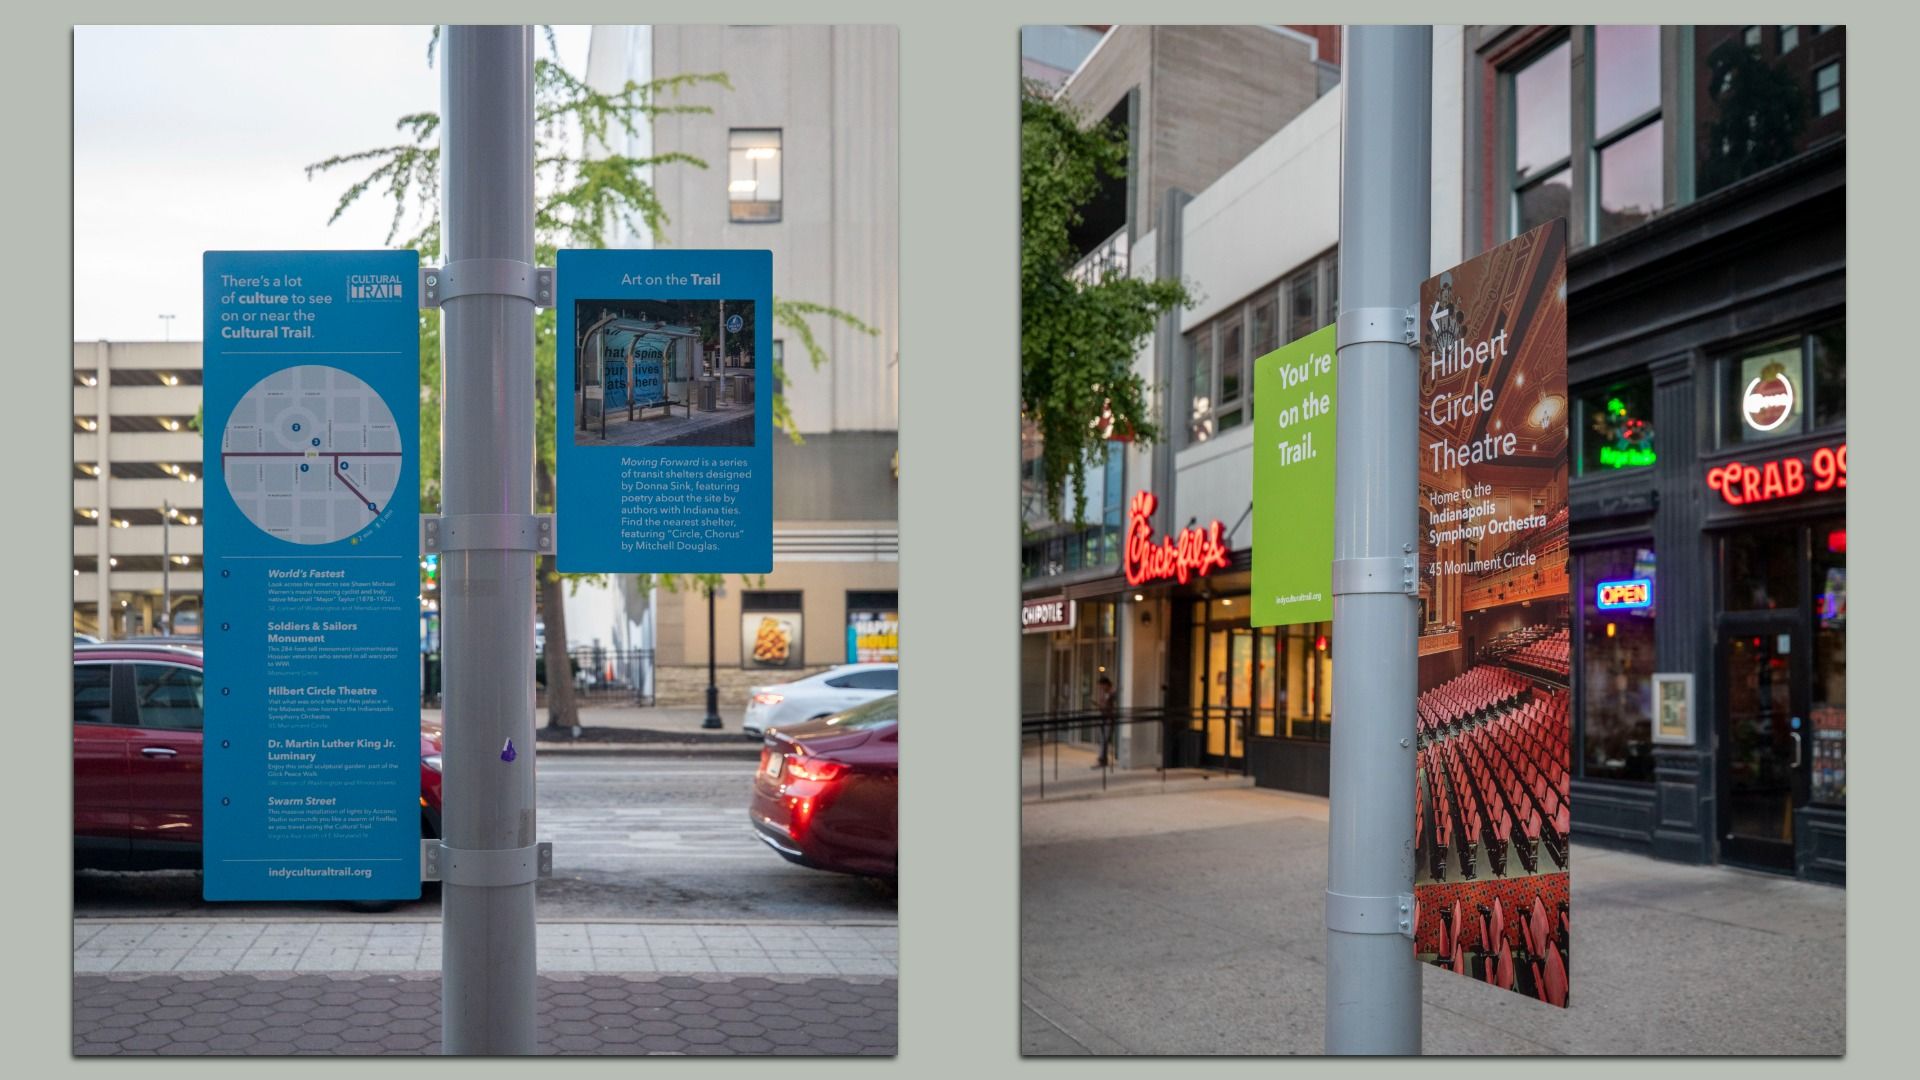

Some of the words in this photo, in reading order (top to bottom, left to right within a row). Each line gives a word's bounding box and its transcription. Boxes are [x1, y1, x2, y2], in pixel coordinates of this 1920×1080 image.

[221, 275, 269, 287] There's
[273, 278, 280, 287] a
[285, 275, 302, 287] lot
[352, 275, 401, 283] CULTURAL
[622, 274, 642, 285] Art
[646, 276, 662, 285] on
[666, 274, 687, 285] the
[691, 274, 720, 285] Trail
[352, 285, 402, 298] TRAIL
[221, 292, 236, 304] of
[239, 292, 288, 304] culture
[292, 294, 305, 304] to
[309, 296, 332, 304] see
[221, 313, 238, 321] on
[243, 313, 256, 321] or
[260, 313, 290, 321] near
[294, 310, 315, 321] the
[221, 327, 277, 338] Cultural
[281, 327, 314, 338] Trail.
[1431, 329, 1508, 380] Hilbert
[635, 363, 660, 375] lives
[1279, 352, 1331, 390] You're
[635, 378, 658, 388] here
[1430, 382, 1494, 426] Circle
[1279, 406, 1299, 429] on
[1302, 392, 1330, 420] the
[1278, 432, 1316, 466] Trail.
[1430, 432, 1517, 472] Theatre
[621, 458, 657, 468] Moving
[660, 458, 699, 466] Forward
[702, 458, 709, 466] is
[720, 458, 747, 466] series
[621, 470, 631, 478] of
[666, 470, 703, 478] shelters
[706, 470, 751, 480] designed
[622, 482, 633, 492] by
[636, 482, 668, 490] Donna
[670, 482, 693, 491] Sink,
[695, 482, 739, 492] featuring
[1707, 458, 1805, 505] CRAB
[622, 495, 653, 504] poetry
[656, 494, 684, 502] about
[686, 494, 702, 502] the
[705, 494, 721, 502] site
[723, 494, 735, 504] by
[1430, 491, 1459, 506] Home
[1462, 488, 1471, 500] to
[1474, 481, 1491, 497] the
[621, 506, 657, 514] authors
[660, 506, 680, 514] with
[683, 506, 719, 514] Indiana
[1430, 500, 1495, 525] Indianapolis
[622, 517, 642, 526] Find
[645, 517, 660, 526] the
[701, 517, 736, 527] shelter,
[621, 529, 665, 540] featuring
[1430, 523, 1486, 547] Symphony
[1489, 514, 1547, 534] Orchestra
[1124, 491, 1232, 586] Chick-fil-A
[622, 541, 633, 552] by
[636, 541, 674, 550] Mitchell
[677, 541, 720, 552] Douglas.
[1430, 562, 1441, 577] 45
[1445, 555, 1501, 575] Monument
[1503, 550, 1536, 568] Circle
[268, 570, 307, 578] World's
[310, 570, 345, 578] Fastest
[1603, 585, 1647, 605] OPEN
[1022, 602, 1063, 624] CHIPOTLE
[268, 622, 310, 630] Soldiers
[313, 622, 320, 630] &
[323, 622, 357, 630] Sailors
[268, 635, 325, 643] Monument
[268, 687, 304, 695] Hilbert
[307, 687, 336, 695] Circle
[339, 687, 377, 695] Theatre
[268, 740, 283, 748] Dr.
[285, 740, 319, 748] Martin
[322, 740, 354, 748] Luther
[357, 740, 381, 750] King
[383, 740, 396, 748] Jr.
[268, 752, 316, 762] Luminary
[268, 797, 303, 805] Swarm
[305, 797, 336, 805] Street
[268, 867, 372, 878] indyculturaltrail.org
